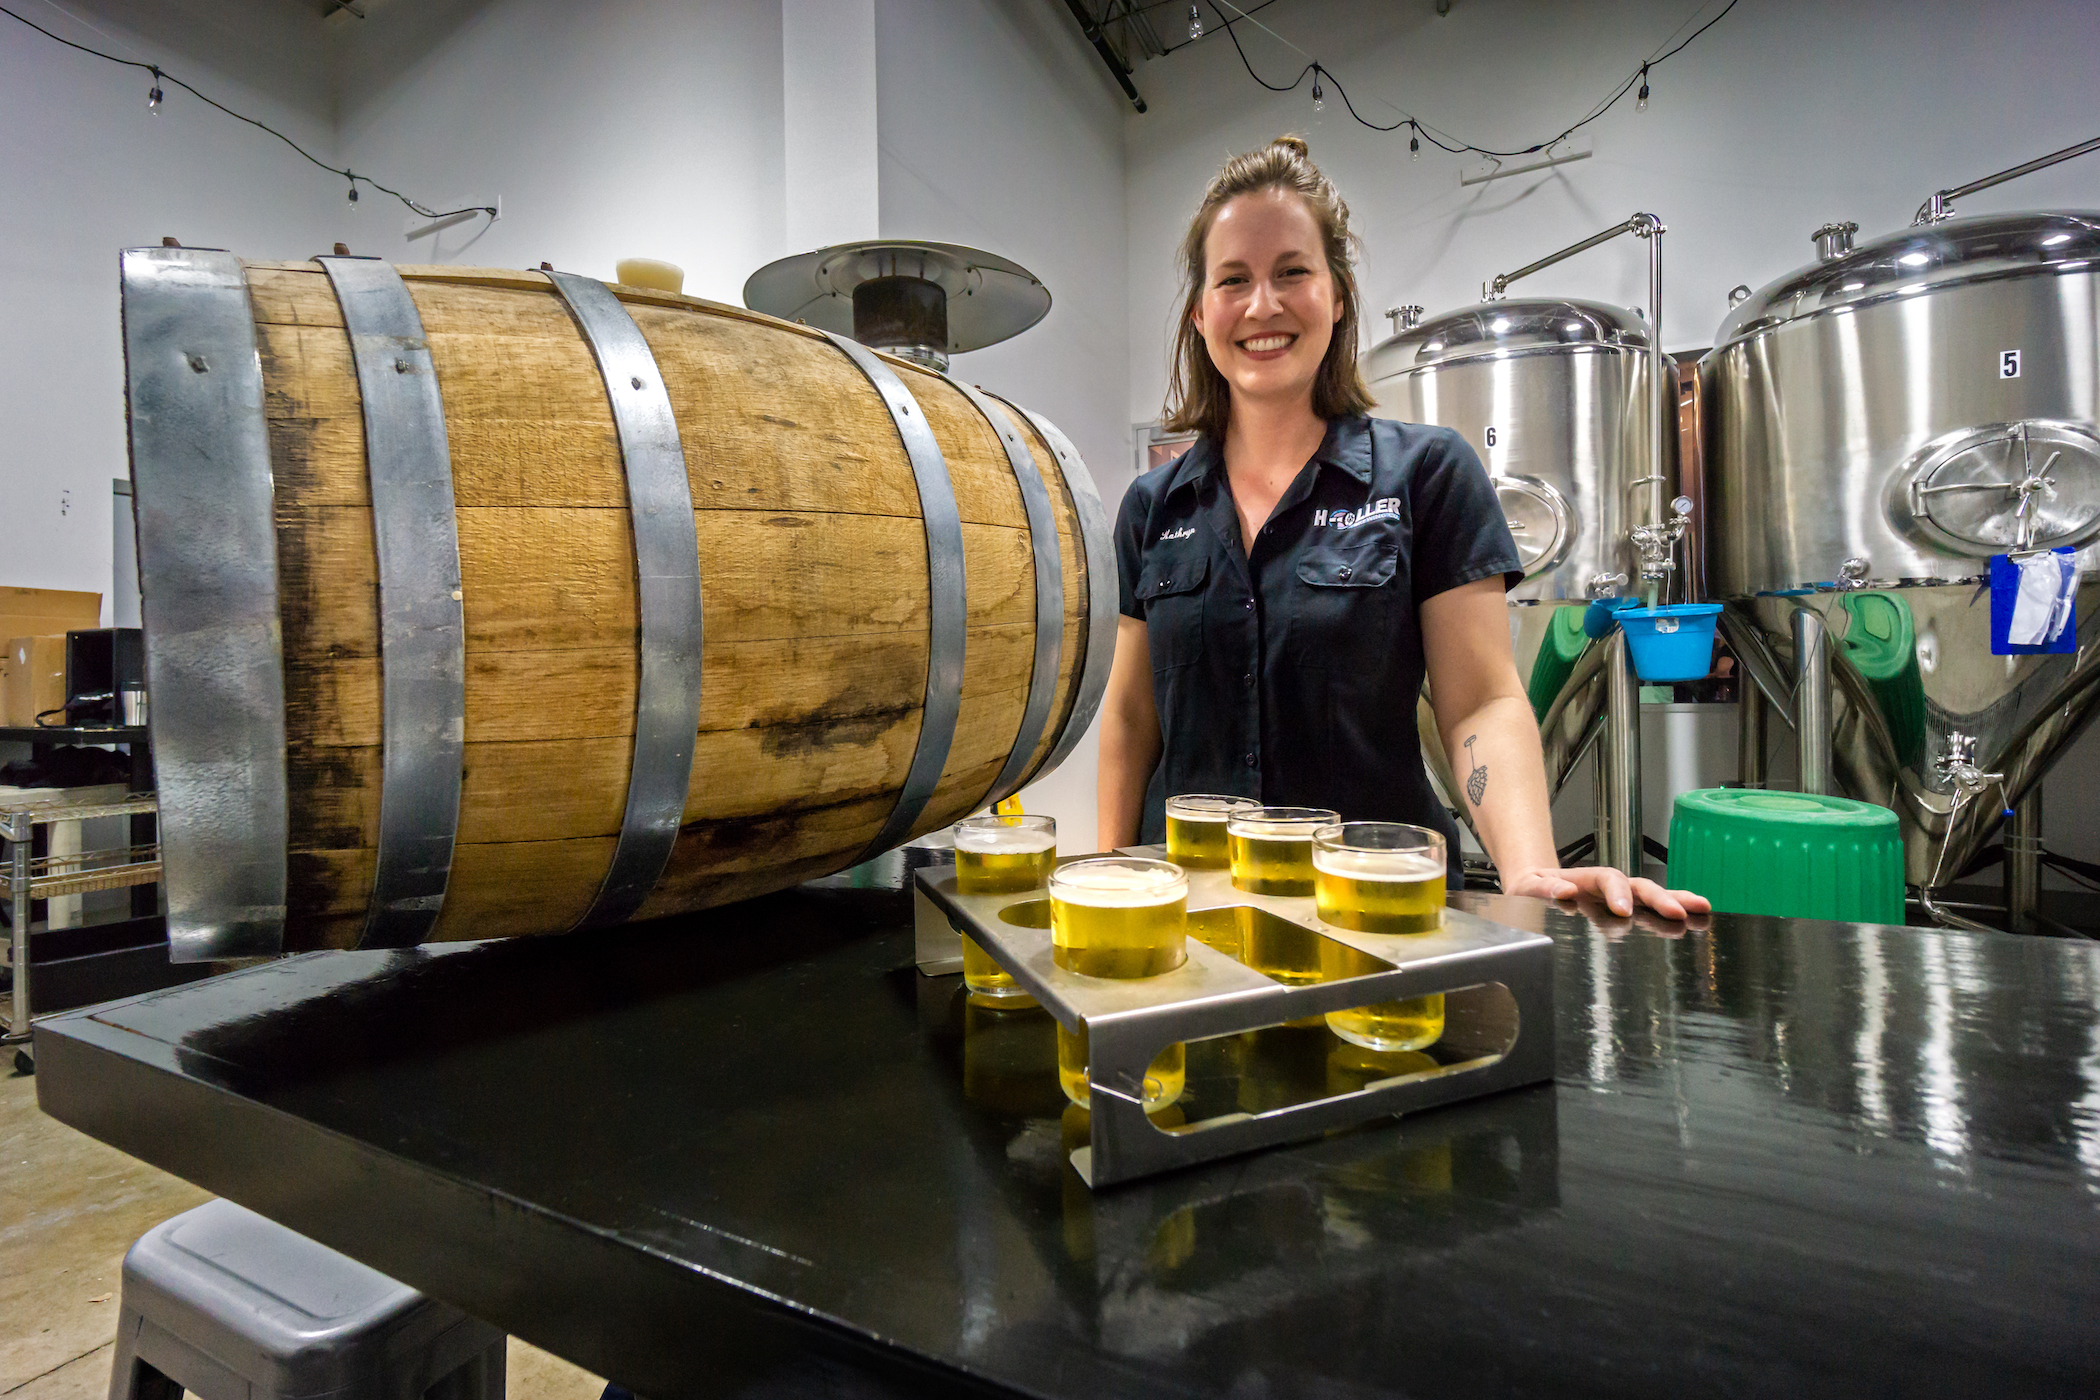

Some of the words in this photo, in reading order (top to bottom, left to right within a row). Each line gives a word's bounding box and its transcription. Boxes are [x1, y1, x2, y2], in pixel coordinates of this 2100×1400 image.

[2004, 352, 2017, 377] 5
[1486, 427, 1497, 447] 6
[1313, 497, 1402, 527] HOLLER
